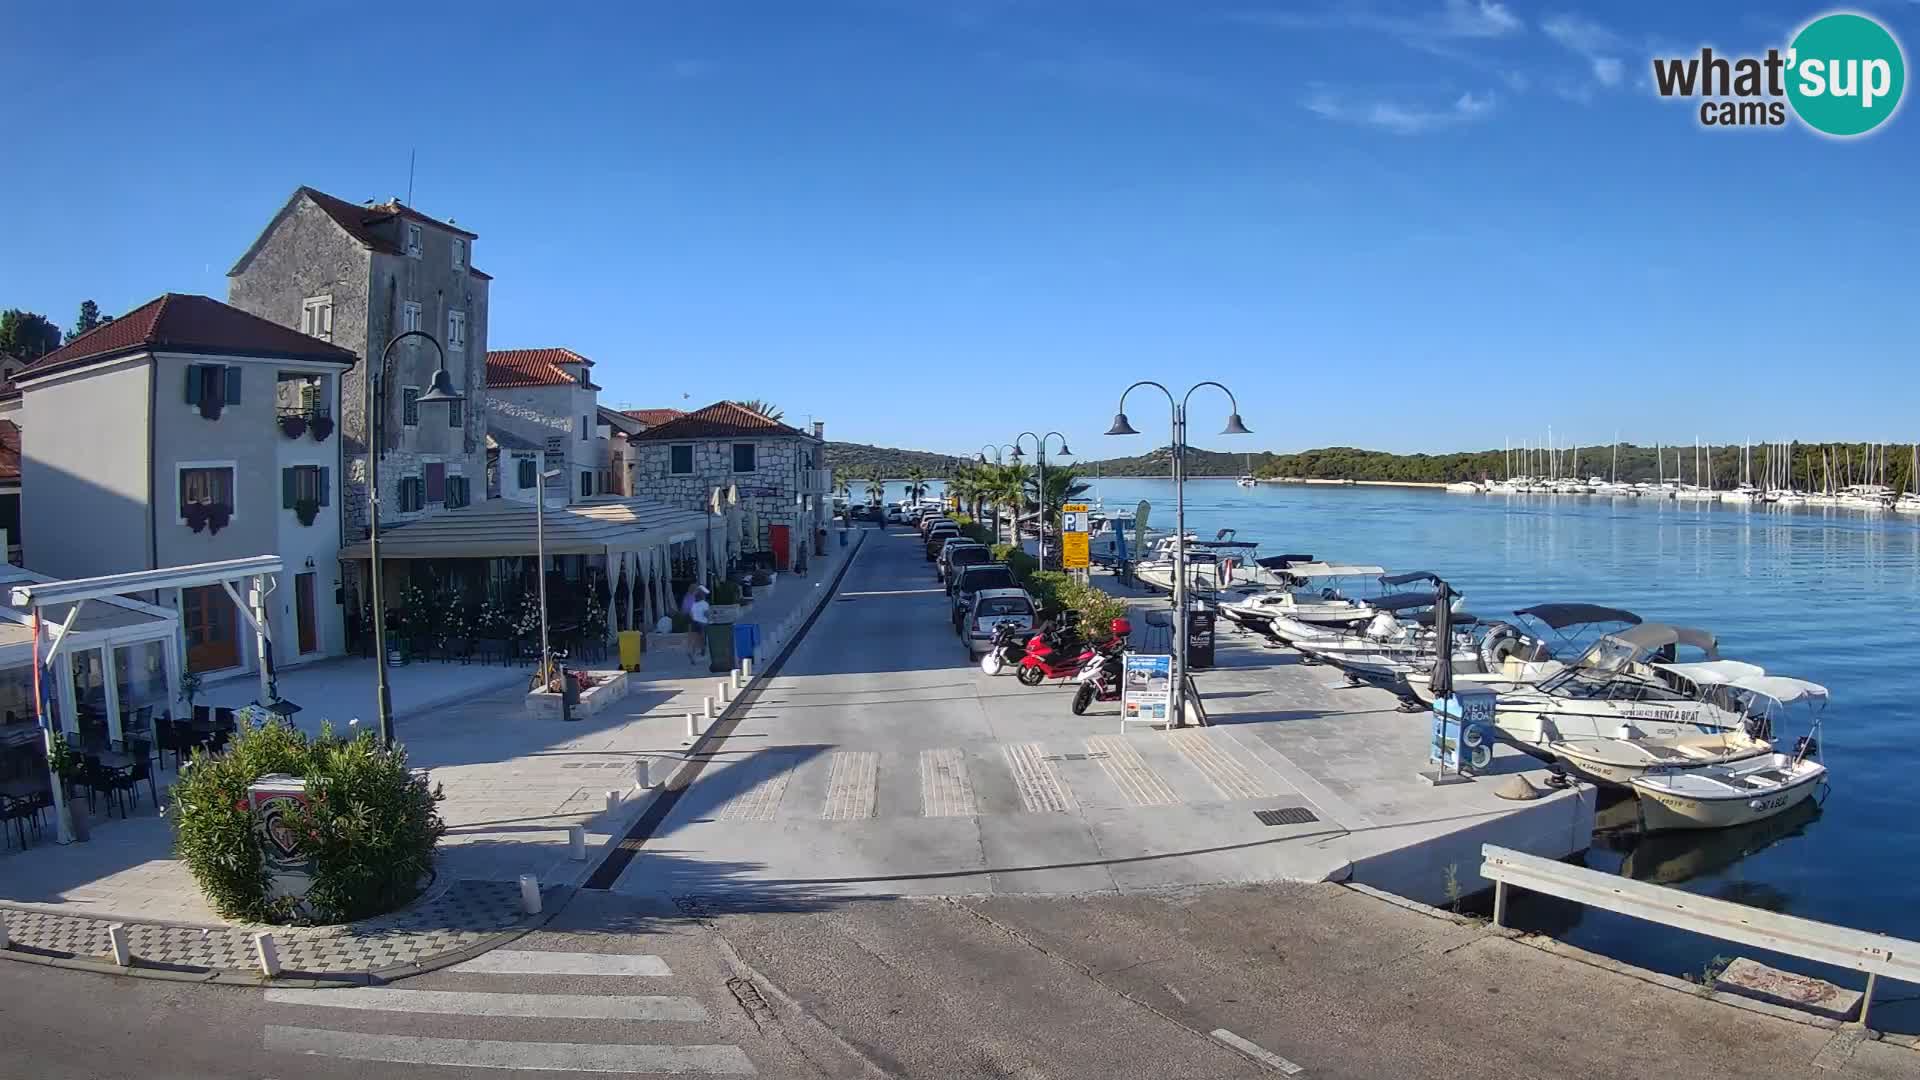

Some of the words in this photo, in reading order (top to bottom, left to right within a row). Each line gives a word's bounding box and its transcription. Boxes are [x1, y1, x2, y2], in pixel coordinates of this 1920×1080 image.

[1064, 514, 1075, 530] P
[1463, 703, 1494, 712] RENT
[1654, 710, 1673, 720] RENT
